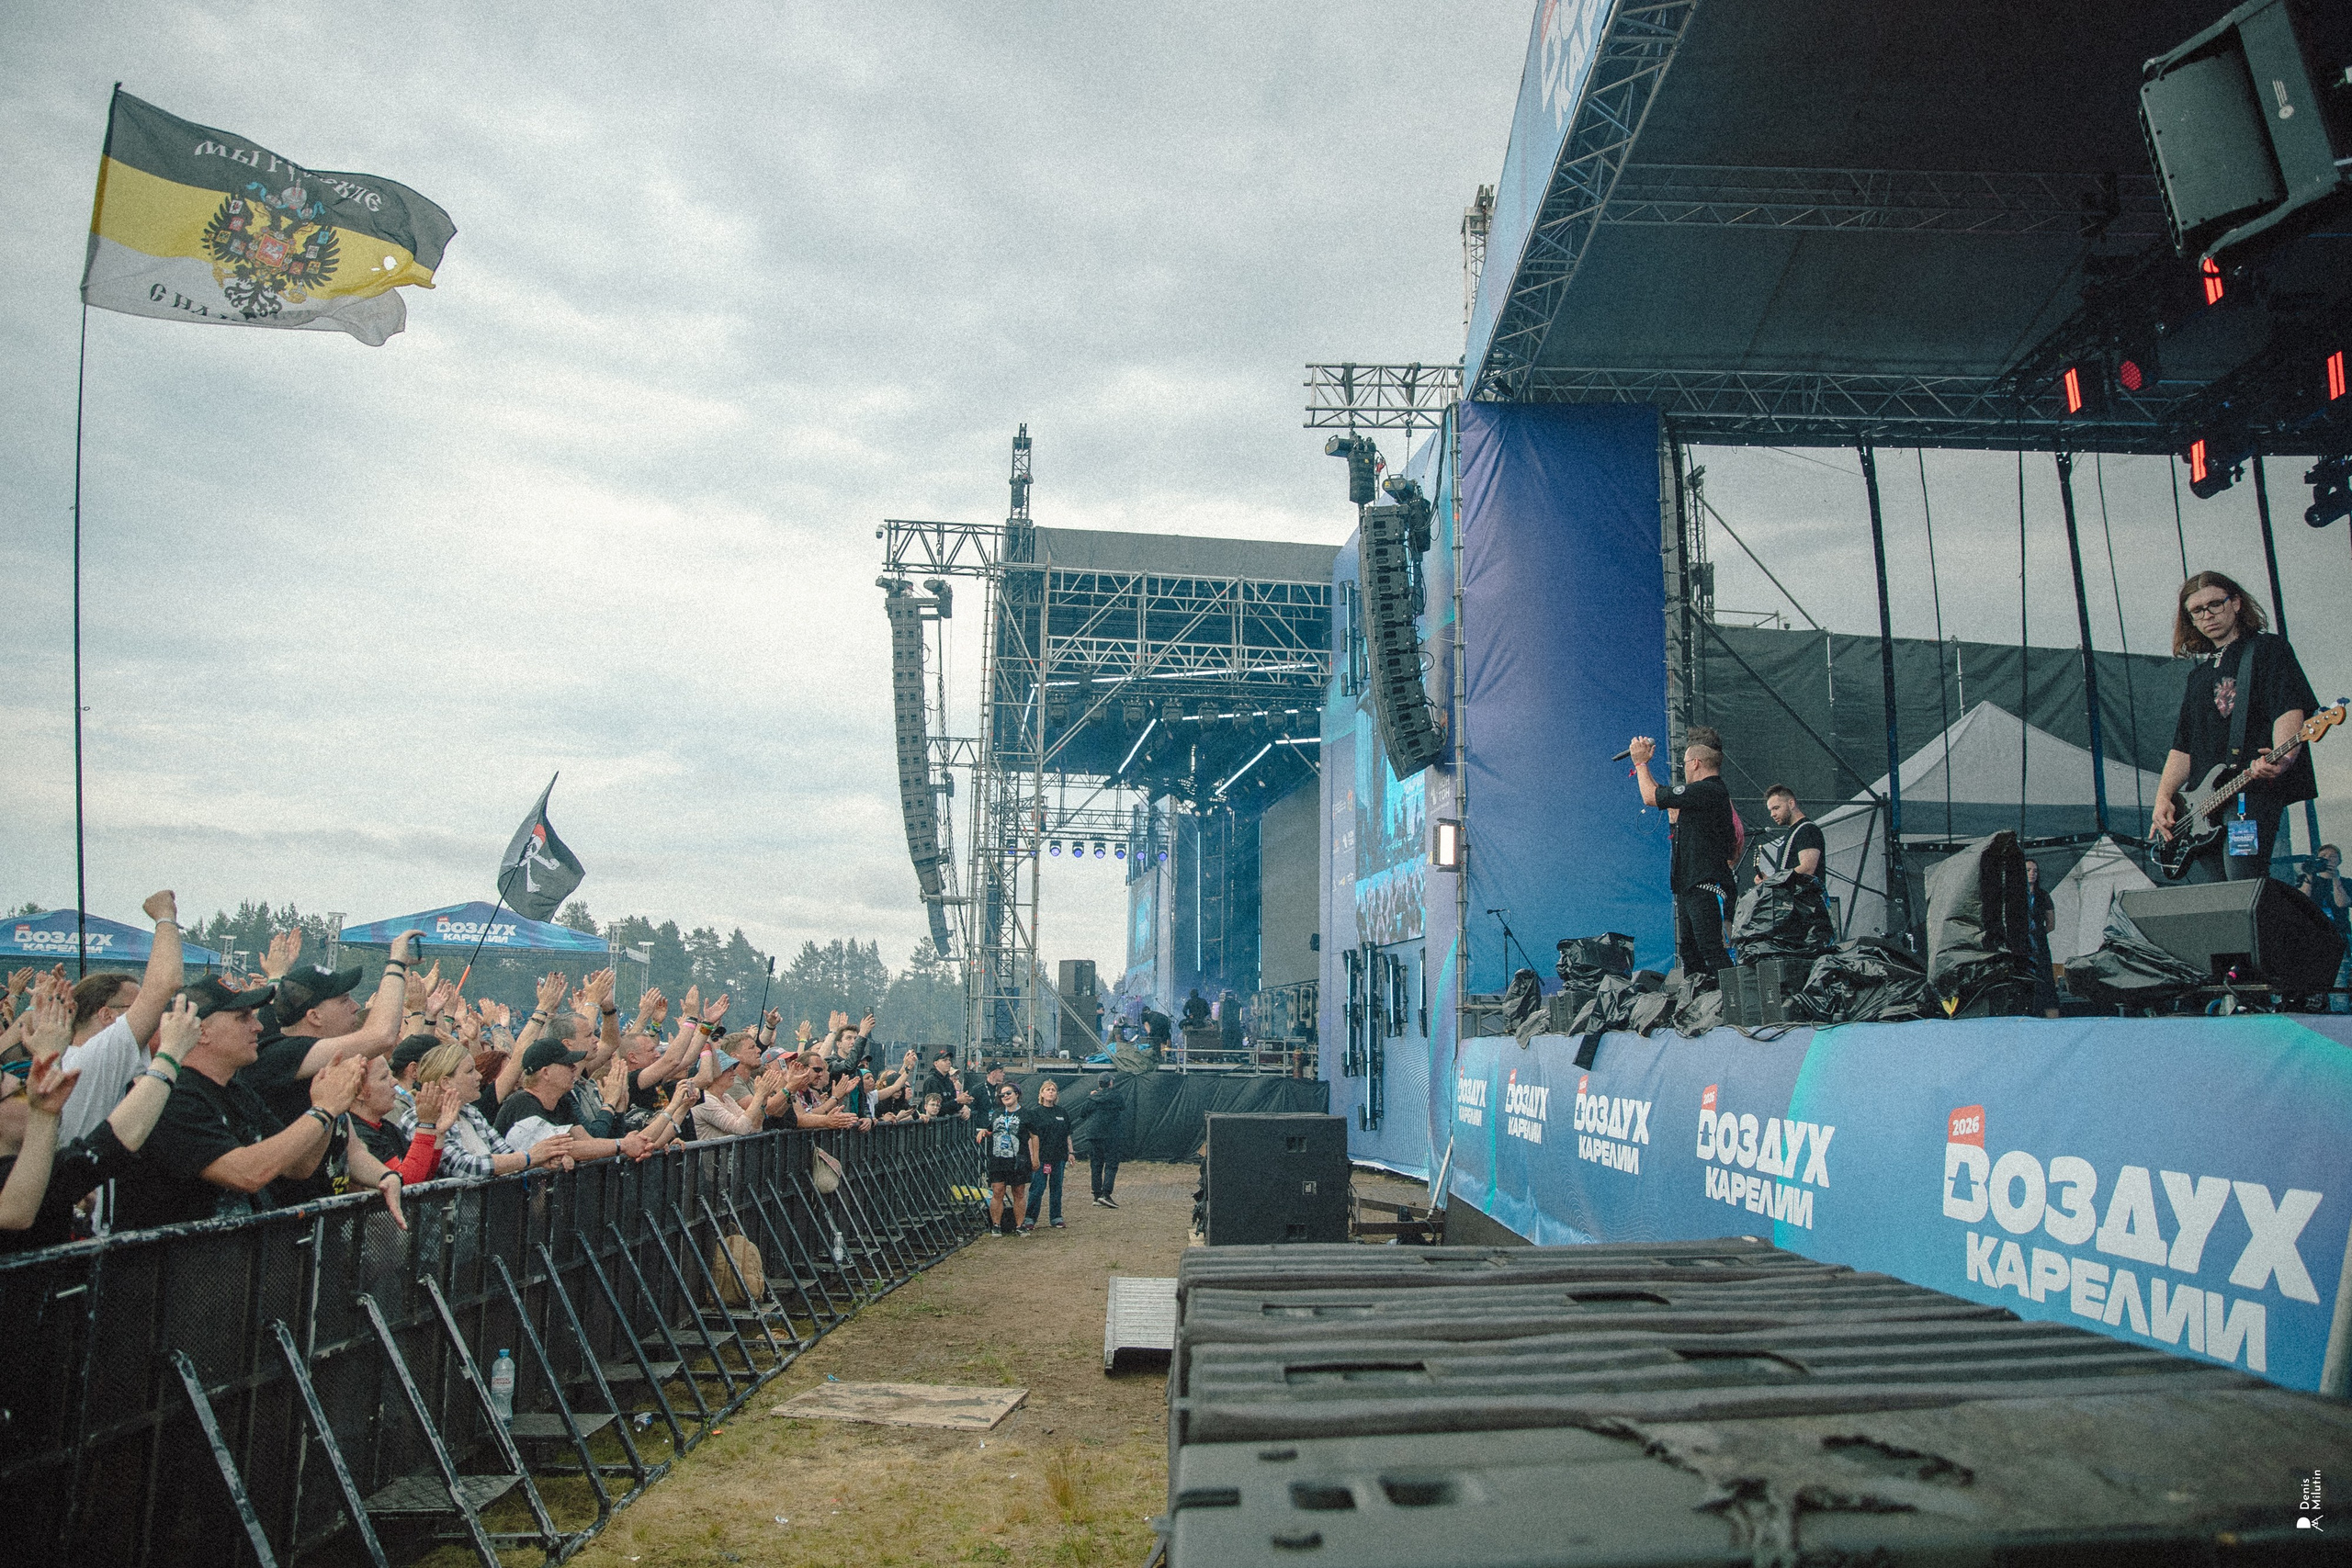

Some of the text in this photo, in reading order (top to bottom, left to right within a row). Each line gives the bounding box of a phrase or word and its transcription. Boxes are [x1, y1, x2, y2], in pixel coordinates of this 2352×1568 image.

[14, 931, 114, 946] ВОЗДУХ
[436, 921, 517, 936] ВОЗДУХ
[1505, 1083, 1549, 1121] ВОЗДУХ
[1574, 1093, 1652, 1145] ВОЗДУХ
[1697, 1109, 1836, 1188] ВОЗДУХ
[1952, 1115, 1980, 1136] 2026
[1578, 1134, 1639, 1175] КАРЕЛИИ
[1705, 1166, 1813, 1230] КАРЕЛИИ
[1942, 1142, 2324, 1303] ВОЗДУХ
[1966, 1231, 2267, 1373] КАРЕЛИИ
